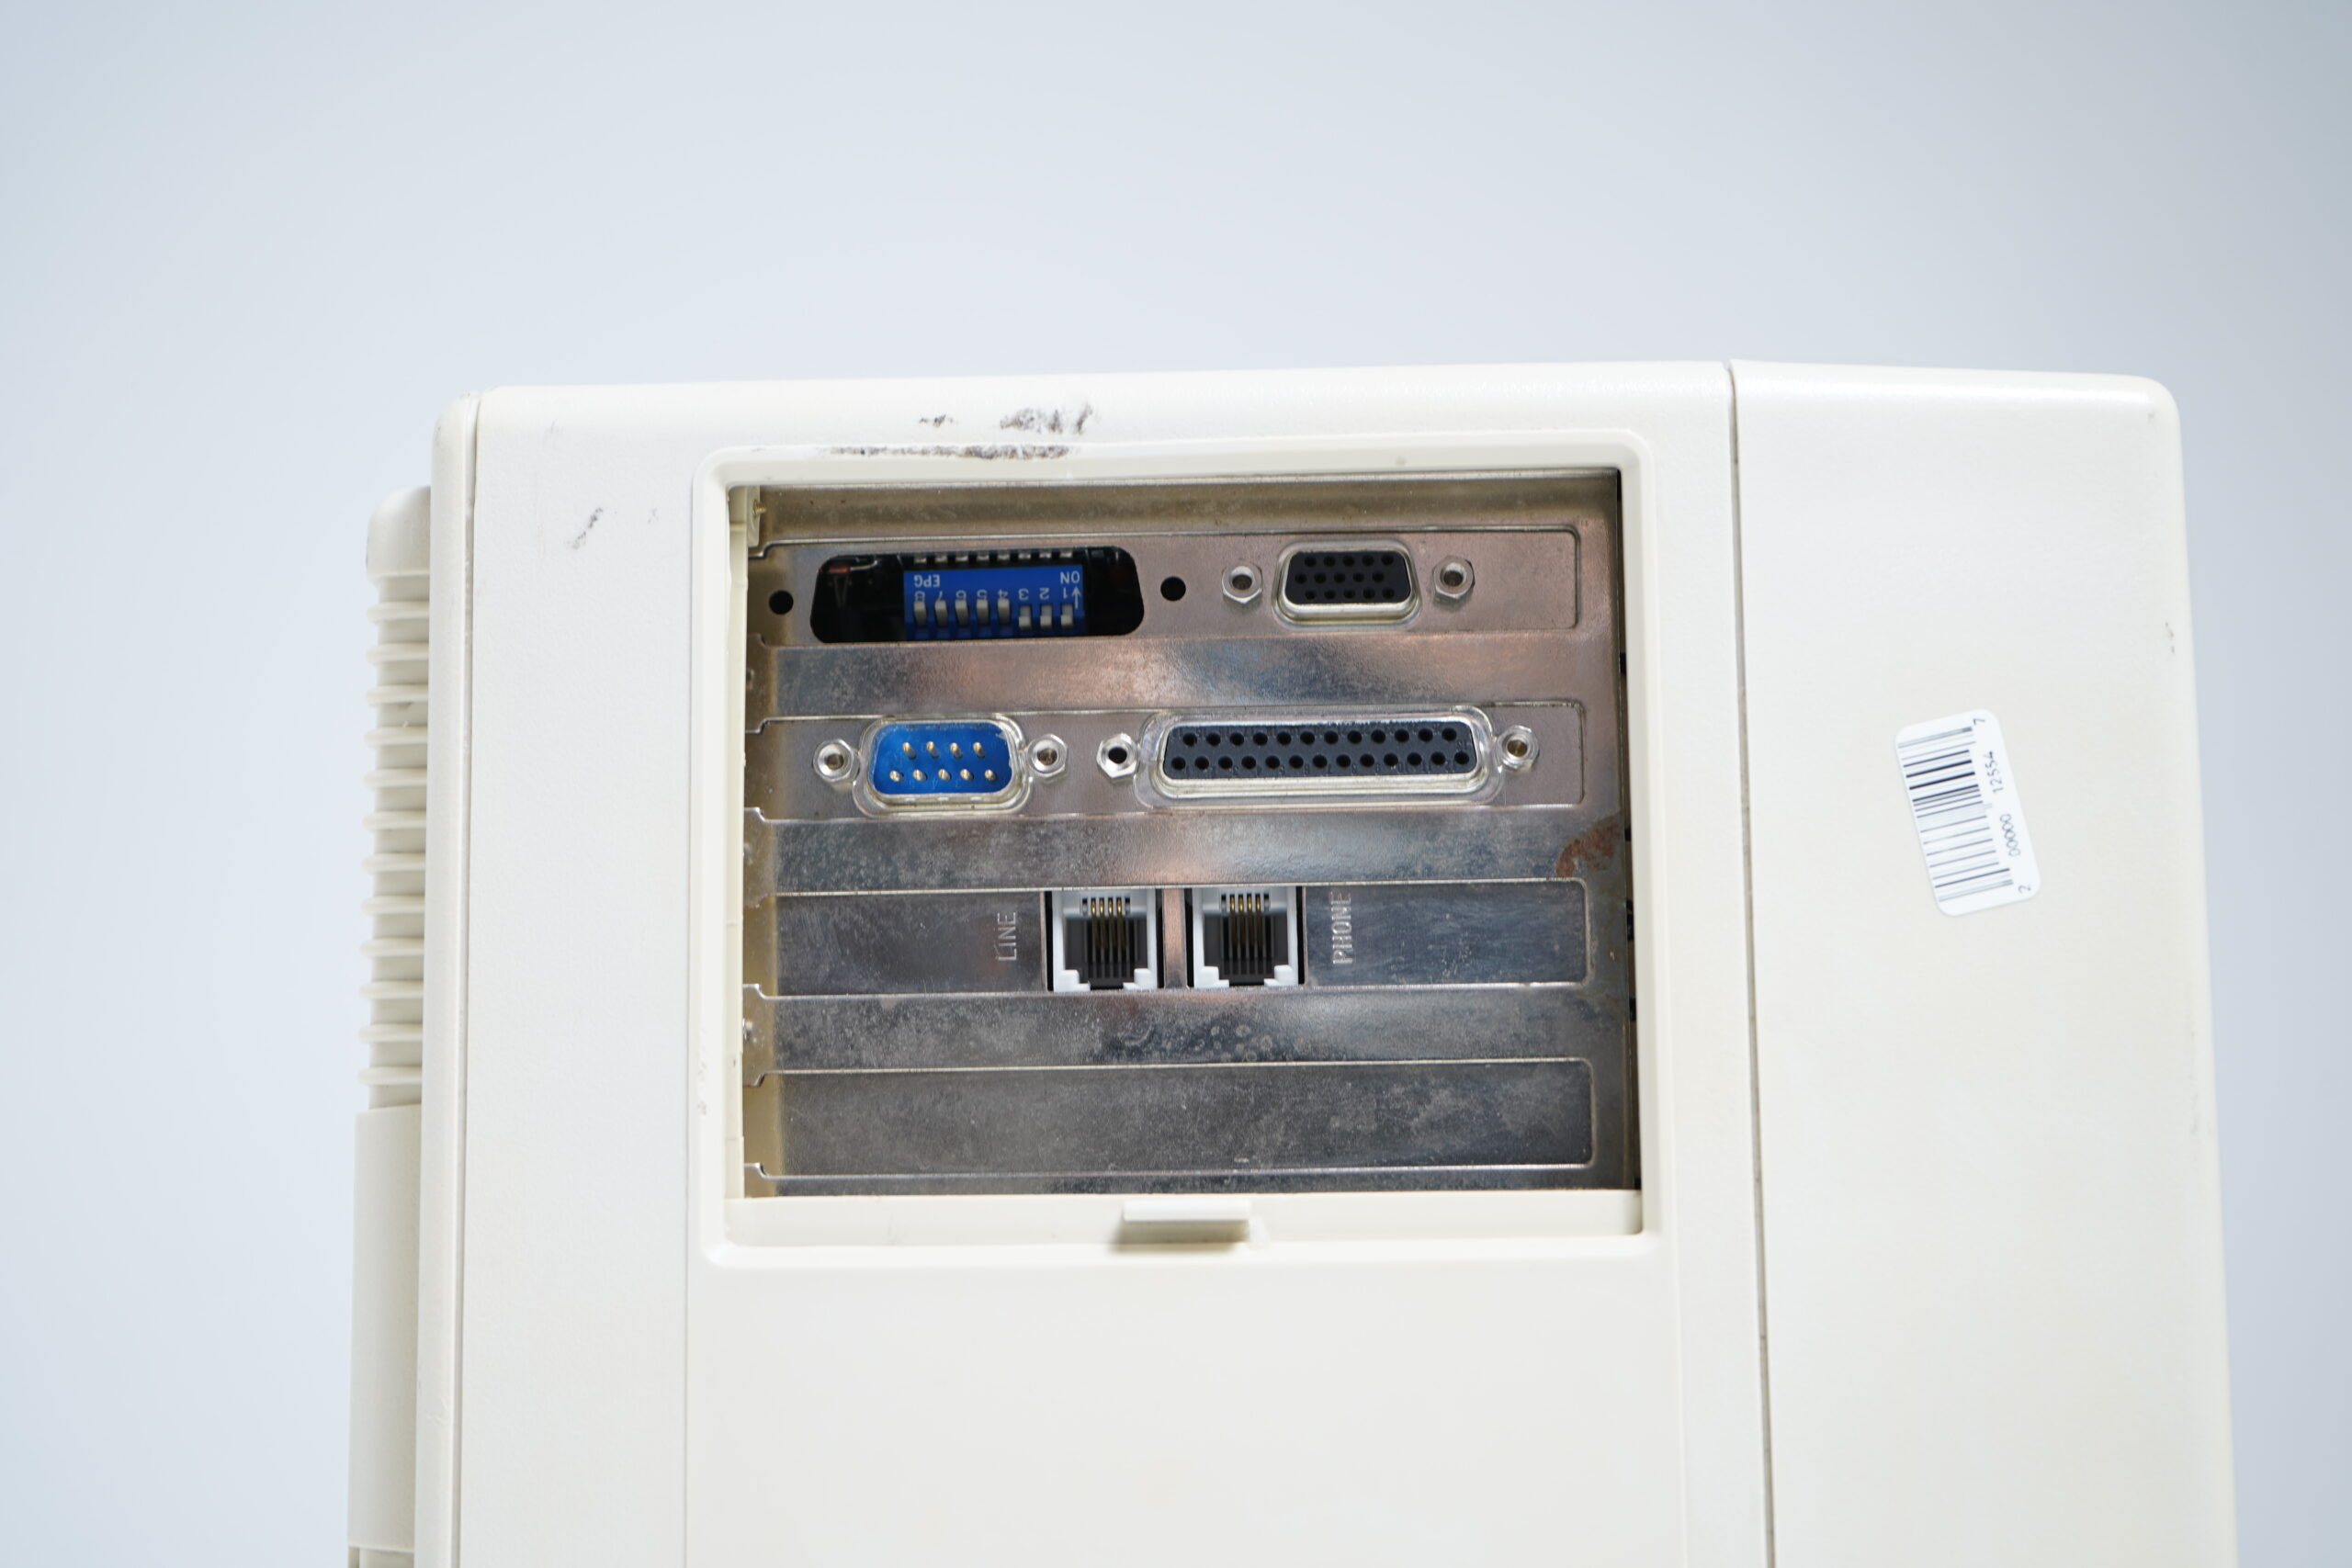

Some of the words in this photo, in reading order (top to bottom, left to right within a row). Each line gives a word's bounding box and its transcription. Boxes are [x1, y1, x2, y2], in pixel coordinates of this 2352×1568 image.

[913, 574, 940, 588] EPG
[1059, 570, 1080, 584] ON
[1018, 588, 1029, 600] 3
[1039, 587, 1050, 600] 2
[1062, 587, 1068, 599] 1
[1973, 717, 1985, 726] 7
[1983, 750, 2004, 794] 12554
[1999, 813, 2021, 857] 00000
[2018, 884, 2031, 894] 2
[1329, 891, 1353, 964] PHONE
[997, 911, 1017, 961] LINE
